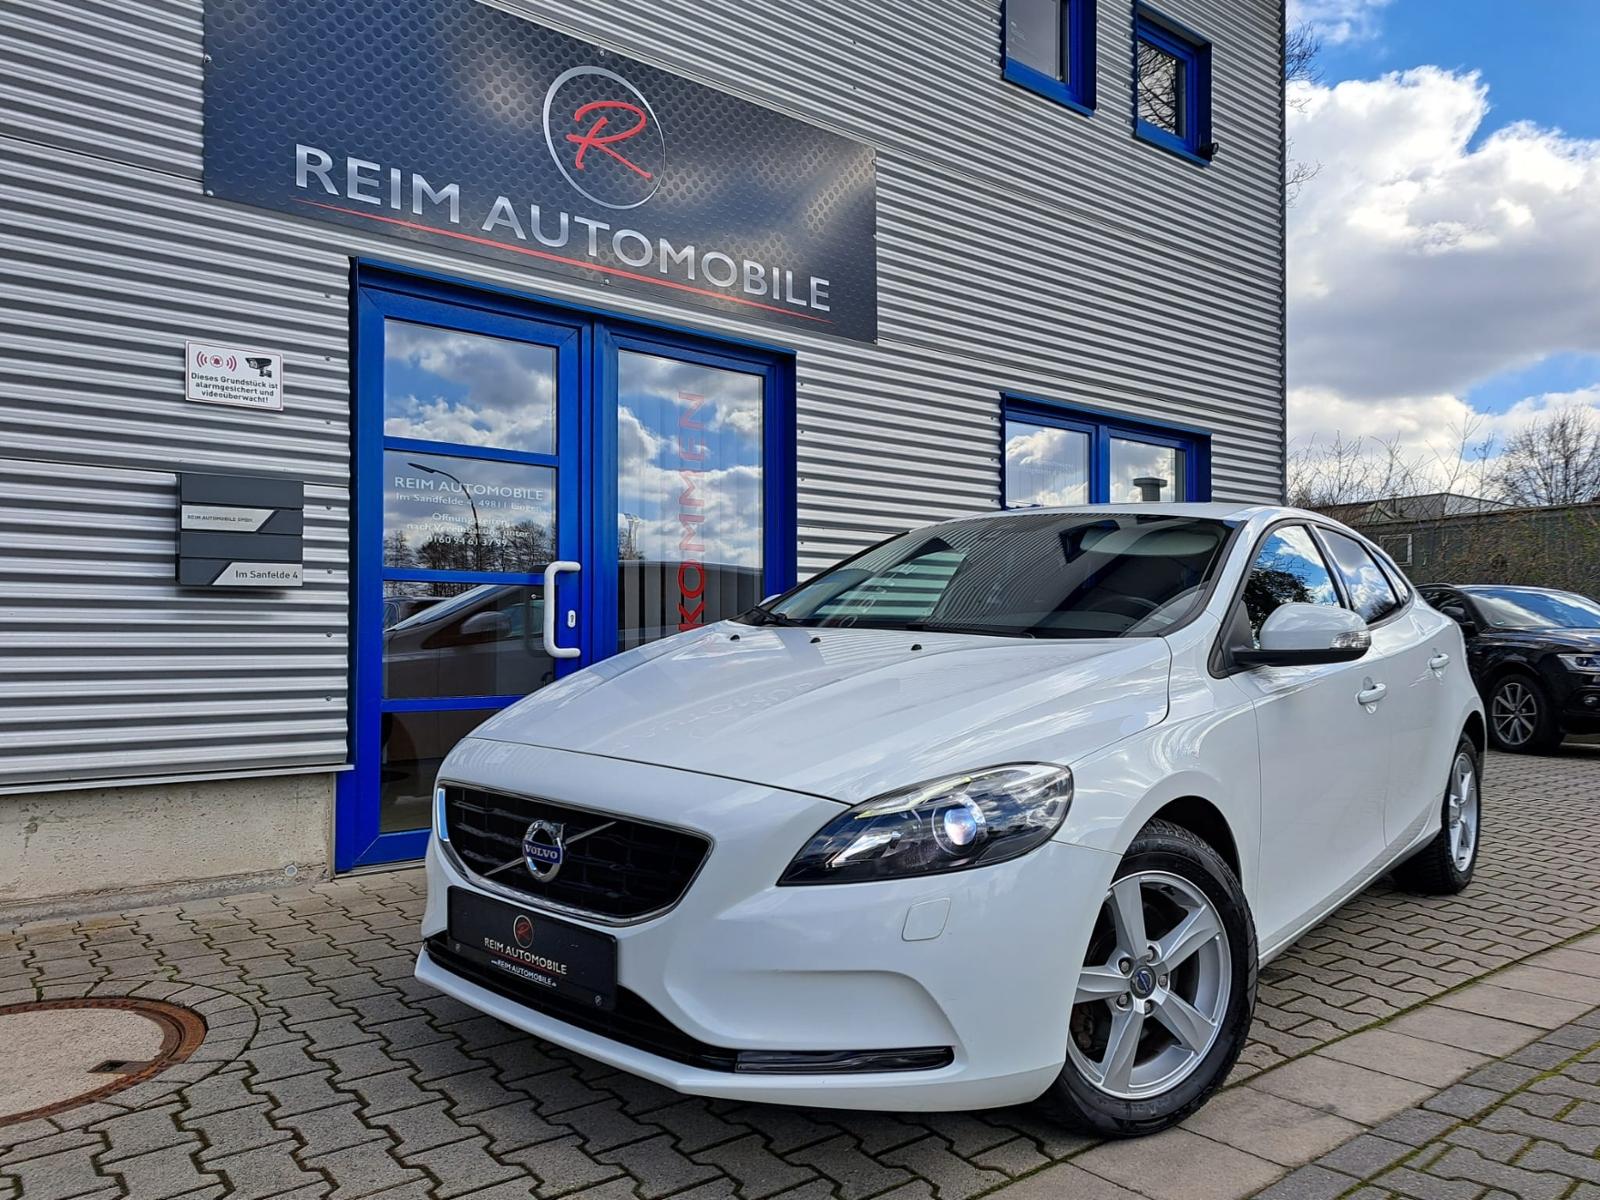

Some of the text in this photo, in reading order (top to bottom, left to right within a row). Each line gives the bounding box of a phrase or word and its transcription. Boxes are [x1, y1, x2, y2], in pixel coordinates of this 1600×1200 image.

[294, 143, 832, 314] REIM AUTOMOBILE
[191, 372, 279, 390] Dieses Grundstück ist
[195, 381, 275, 397] alarmgesichert und
[201, 389, 269, 404] videoüberwacht!
[394, 476, 545, 501] REIM AUTOMOBILE
[396, 492, 410, 502] Im
[414, 494, 464, 506] Sandfelde
[235, 570, 299, 580] Im Sanfelde 4
[524, 844, 559, 860] VOLVO
[484, 936, 568, 976] REIM AUTOMOBILE
